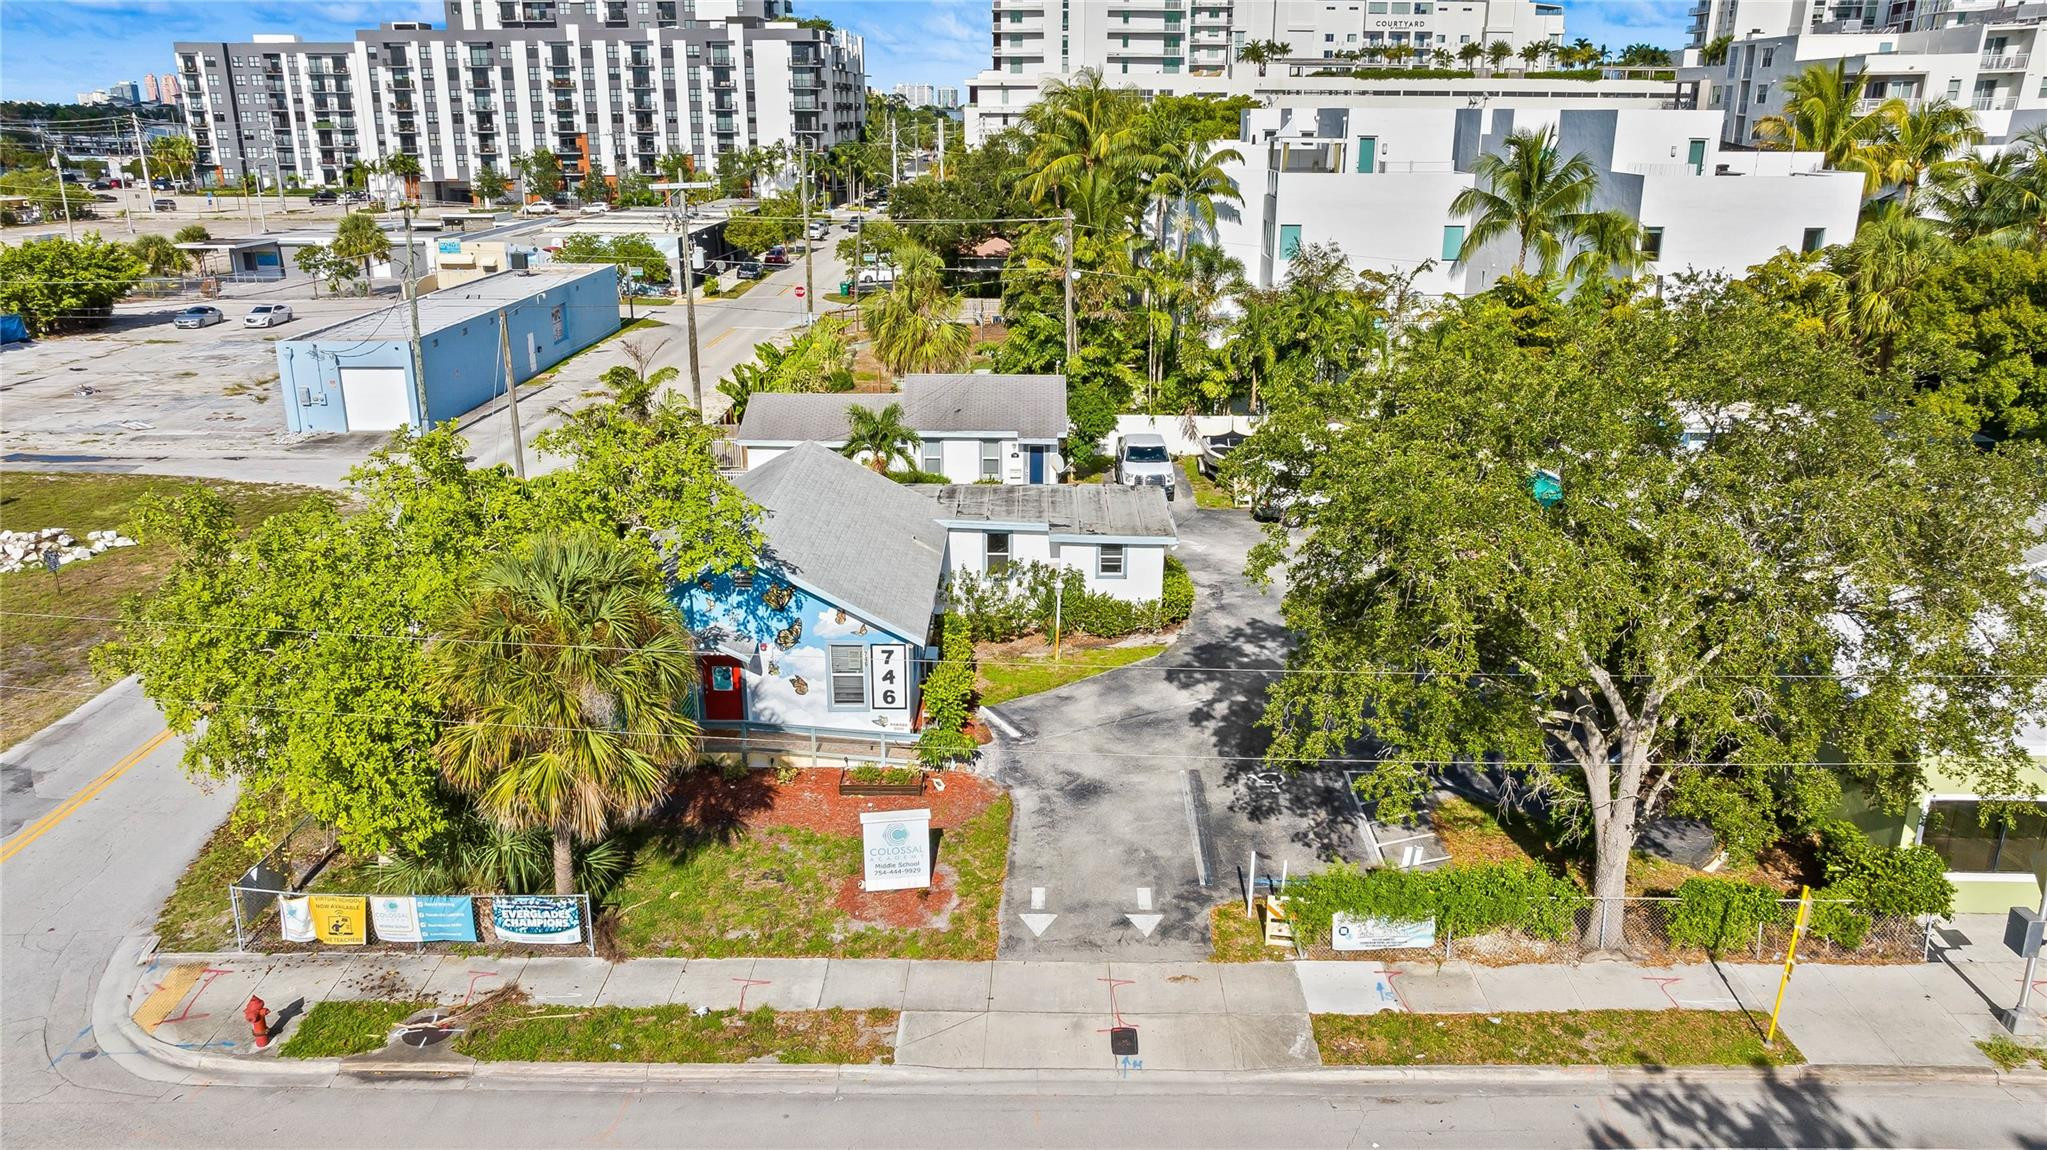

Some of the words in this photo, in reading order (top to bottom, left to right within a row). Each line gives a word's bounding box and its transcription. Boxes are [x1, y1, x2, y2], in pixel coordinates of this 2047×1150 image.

[881, 649, 896, 704] 746
[869, 845, 923, 856] COLOSSAL
[898, 860, 920, 868] School
[330, 903, 360, 911] AVAILABLE
[502, 910, 571, 919] EVERGLADES
[504, 919, 569, 928] CHAMPIONS
